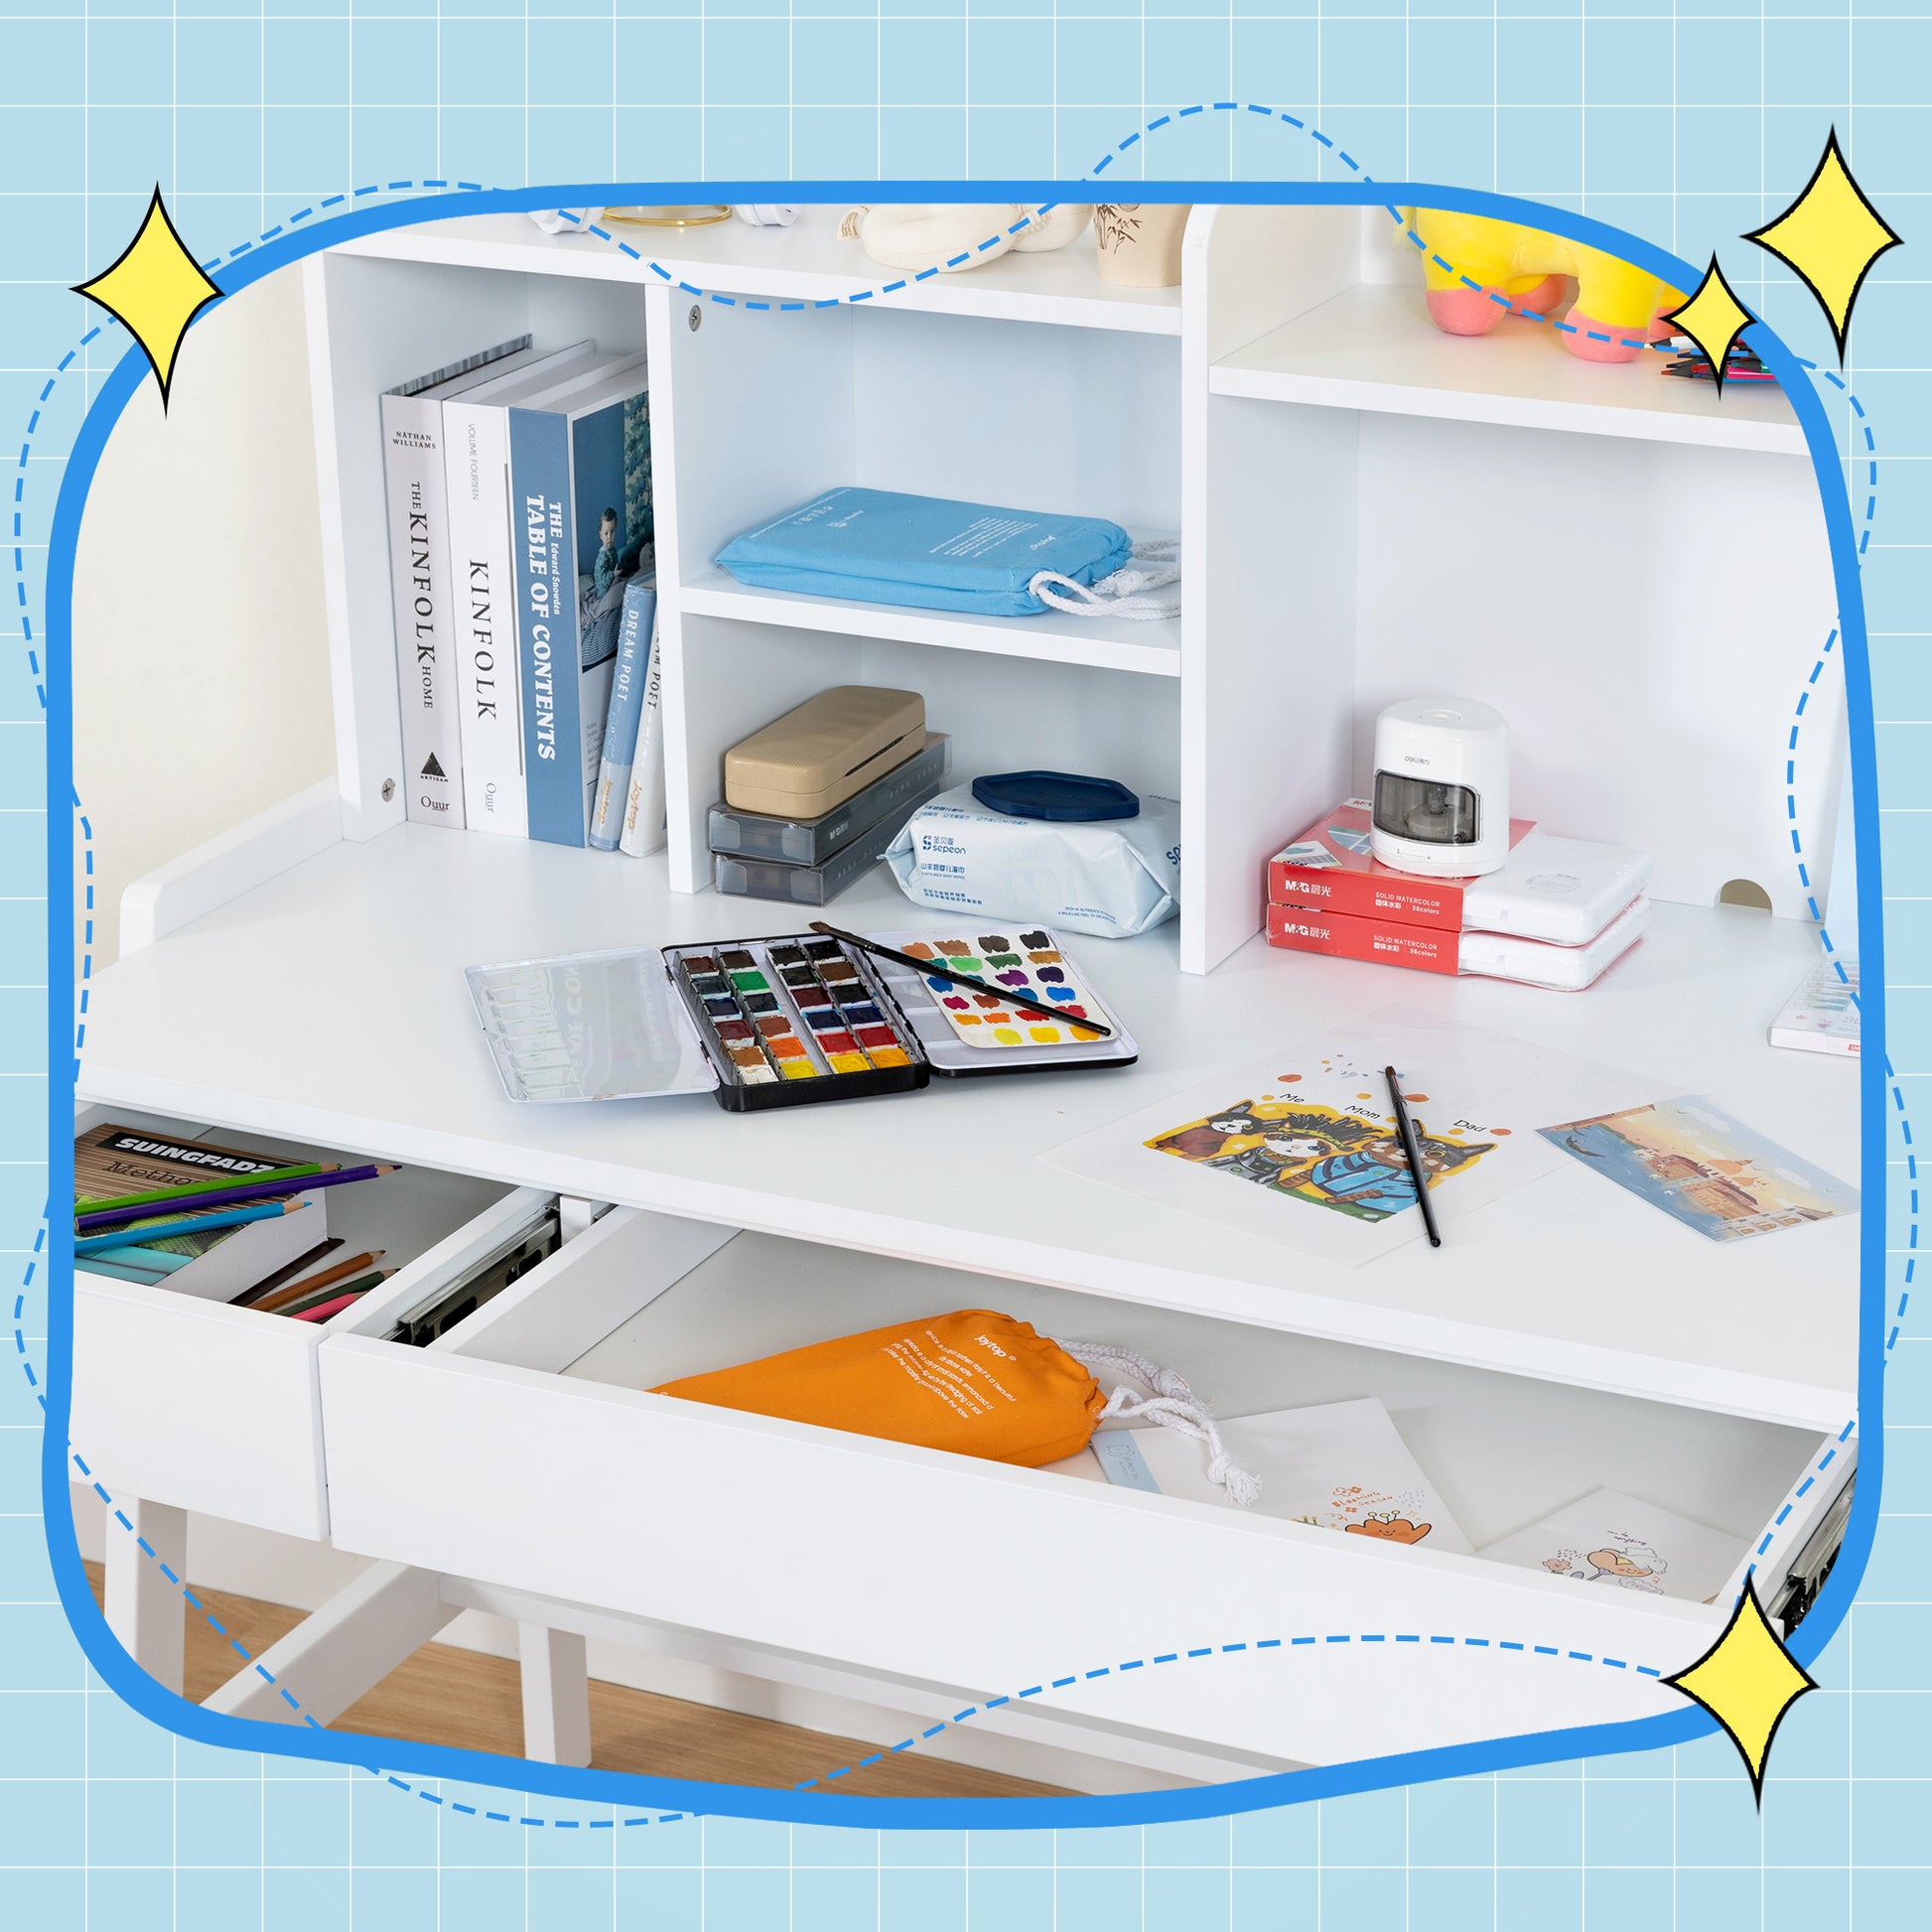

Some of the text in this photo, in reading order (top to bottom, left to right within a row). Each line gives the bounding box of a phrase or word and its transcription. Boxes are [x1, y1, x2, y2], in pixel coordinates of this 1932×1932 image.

[396, 431, 432, 441] NATHAN
[393, 438, 436, 450] WILLIAMS
[469, 423, 479, 500] VOLUME FOURTEEN
[549, 501, 563, 616] THE Edward Snowden
[409, 482, 436, 709] THE KINFOLK HOME
[526, 494, 556, 760] TABLE OF CONTENTS
[470, 559, 496, 720] KINFOLK
[617, 610, 639, 702] DREAM POET
[421, 795, 450, 812] Ouur
[485, 782, 496, 813] Ouur
[932, 844, 967, 855] sepeon
[1285, 880, 1310, 894] M&G
[1311, 884, 1332, 897] 晨光
[1375, 892, 1441, 907] SOLID WATERCOLOR
[1411, 905, 1440, 915] 36colors
[1284, 922, 1310, 936] M&G
[1310, 926, 1331, 940] 晨光
[1373, 934, 1438, 950] SOLID WATERCOLOR
[1409, 948, 1438, 958] 36colors
[1279, 1093, 1305, 1104] Me
[1344, 1105, 1380, 1120] Mom
[1453, 1119, 1487, 1133] Dad
[102, 1162, 210, 1185] Metho
[974, 1334, 1007, 1357] joytop
